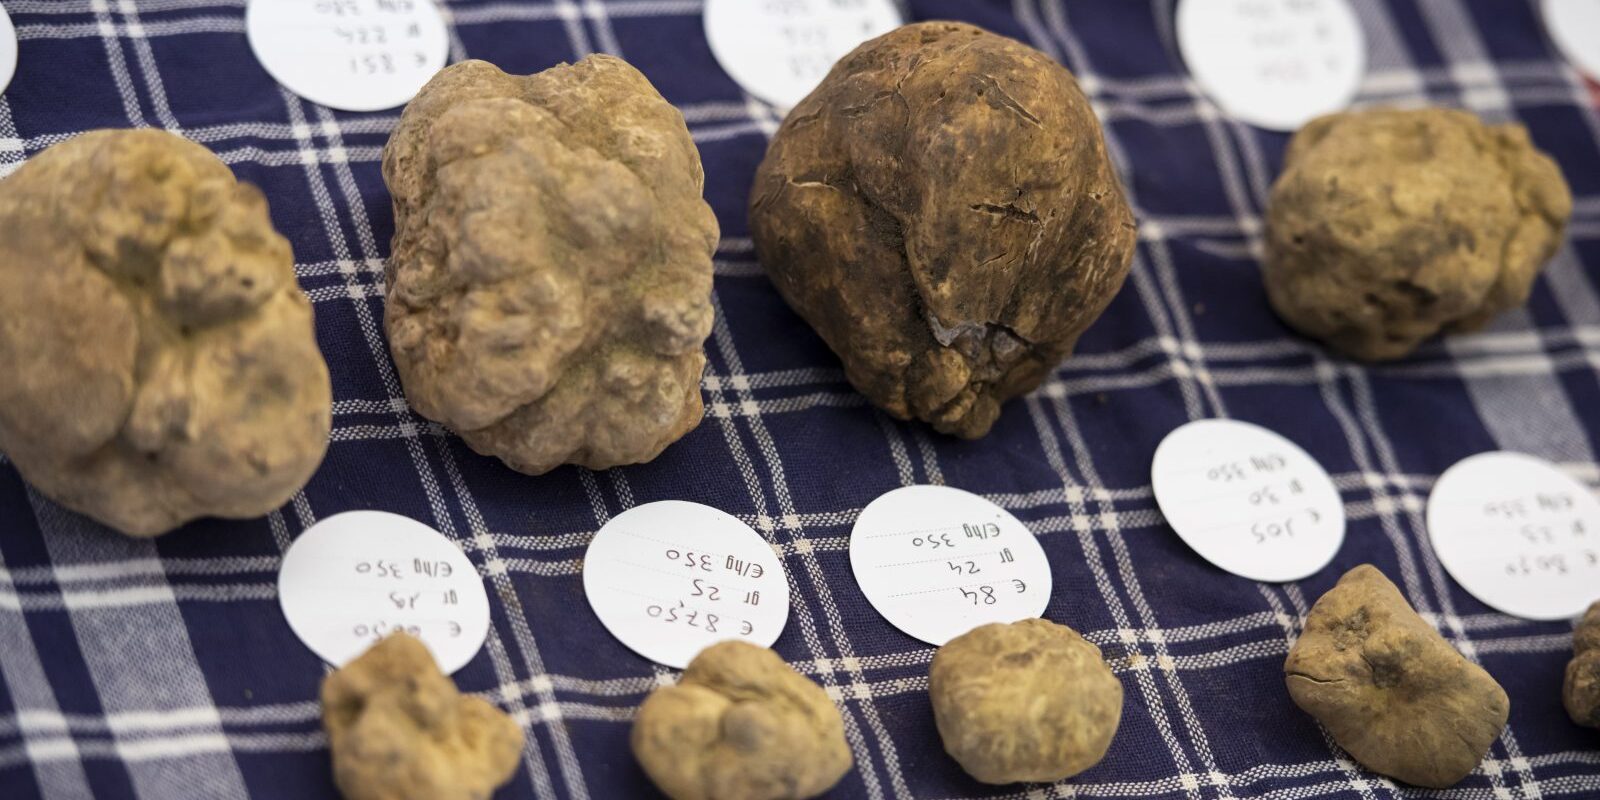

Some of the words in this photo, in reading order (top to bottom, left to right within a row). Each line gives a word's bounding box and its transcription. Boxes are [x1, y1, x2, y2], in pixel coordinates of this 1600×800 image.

[1207, 462, 1246, 482] 350
[1249, 486, 1279, 506] 30
[962, 523, 1000, 540] €/hg
[912, 534, 955, 549] 350
[666, 550, 712, 572] 350
[998, 548, 1014, 563] gr
[355, 560, 403, 579] 350
[413, 558, 452, 577] €/hg
[726, 555, 764, 578] €/hg
[947, 561, 980, 575] 24
[691, 579, 720, 601] 25
[1012, 579, 1026, 593] €
[442, 590, 458, 605] gr
[744, 591, 759, 606] gr
[959, 586, 996, 605] 84
[646, 601, 719, 633] 87,50
[448, 621, 461, 636] €
[740, 621, 753, 635] €
